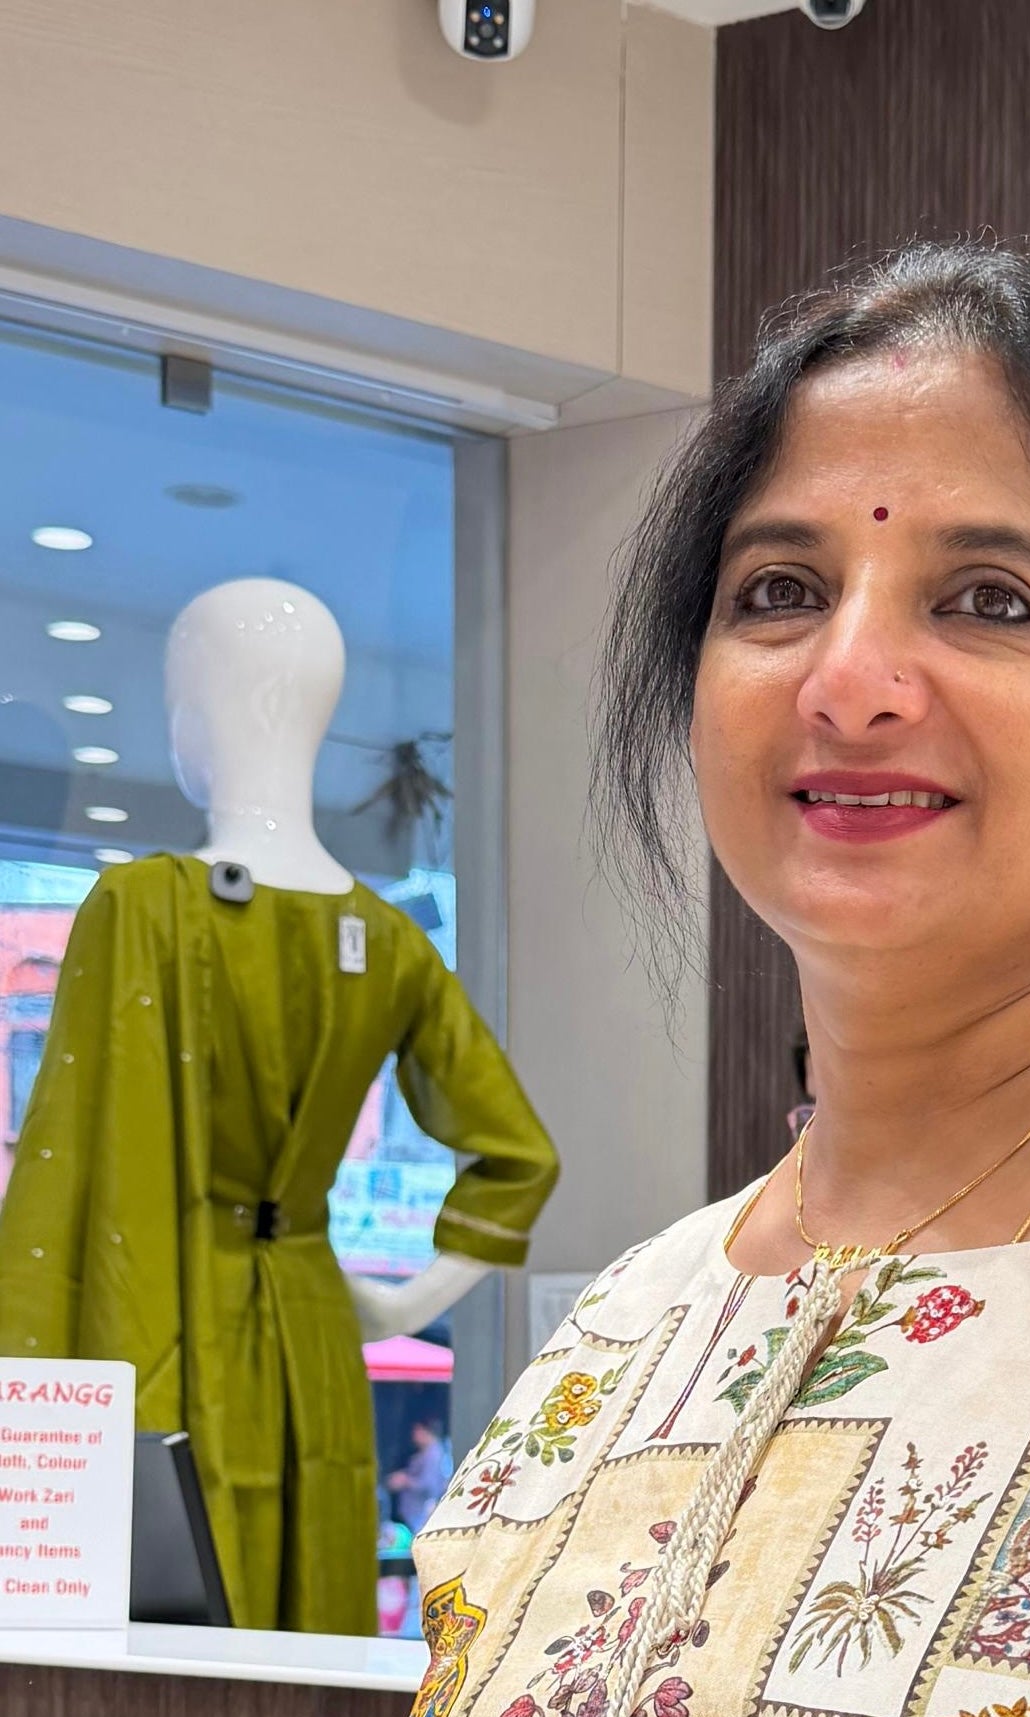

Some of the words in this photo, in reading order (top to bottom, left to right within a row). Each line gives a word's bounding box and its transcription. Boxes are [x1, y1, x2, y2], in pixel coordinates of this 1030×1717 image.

[0, 1381, 113, 1407] RANGG
[1, 1427, 81, 1444] Guarantee
[87, 1430, 102, 1444] of
[37, 1453, 87, 1470] Colour
[0, 1487, 37, 1503] Work
[43, 1487, 74, 1503] Zari
[20, 1517, 48, 1530] and
[38, 1543, 81, 1558] Items
[5, 1578, 49, 1594] Clean
[56, 1578, 90, 1597] Only
